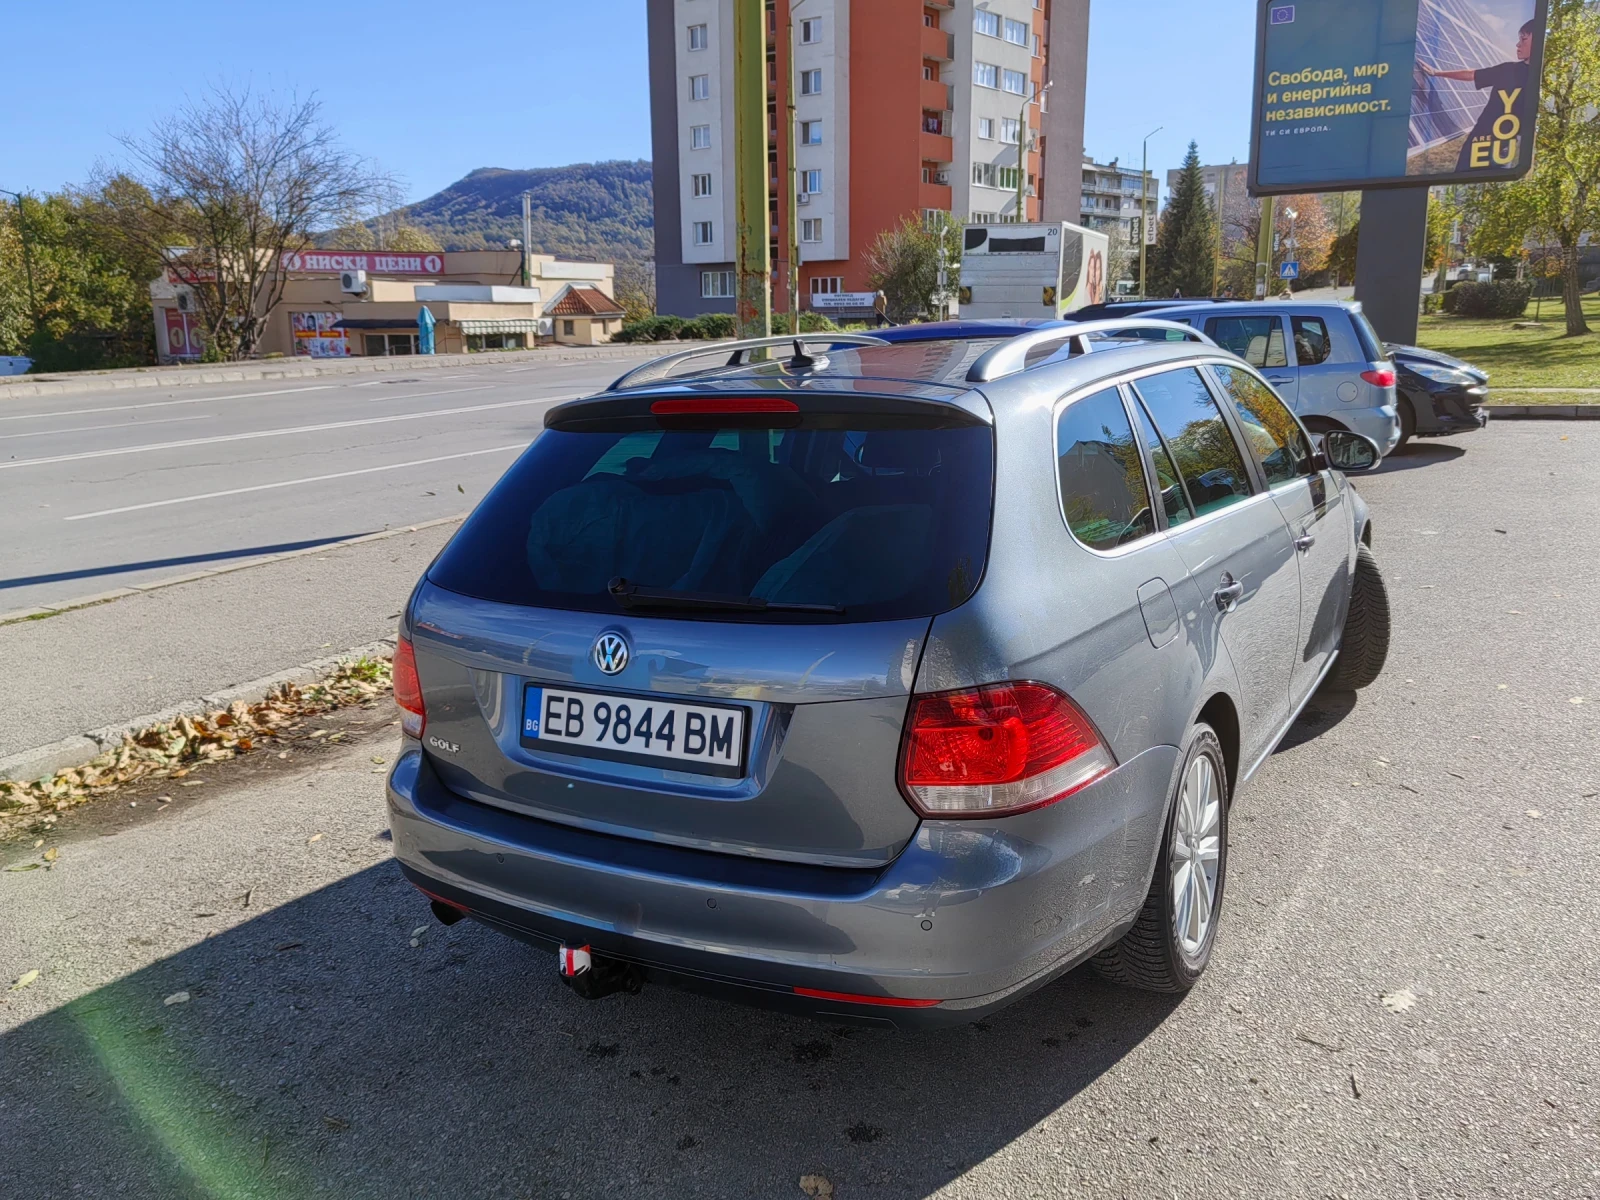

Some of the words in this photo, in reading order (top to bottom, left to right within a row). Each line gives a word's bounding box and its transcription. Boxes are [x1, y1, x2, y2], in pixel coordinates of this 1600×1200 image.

[1268, 68, 1348, 87] Свобода,
[1353, 62, 1389, 78] мир
[1267, 93, 1277, 104] и
[1282, 83, 1372, 104] енергийна
[1266, 98, 1392, 122] независимост.
[1294, 125, 1332, 134] ЕВРОПА.
[1472, 135, 1491, 143] ARE
[1047, 228, 1058, 236] 20
[304, 255, 368, 271] НИСКИ
[374, 256, 422, 272] ЦЕНИ
[525, 718, 539, 732] BG
[593, 701, 676, 752] 9844
[683, 711, 735, 760] BM
[429, 735, 460, 753] GOLF
